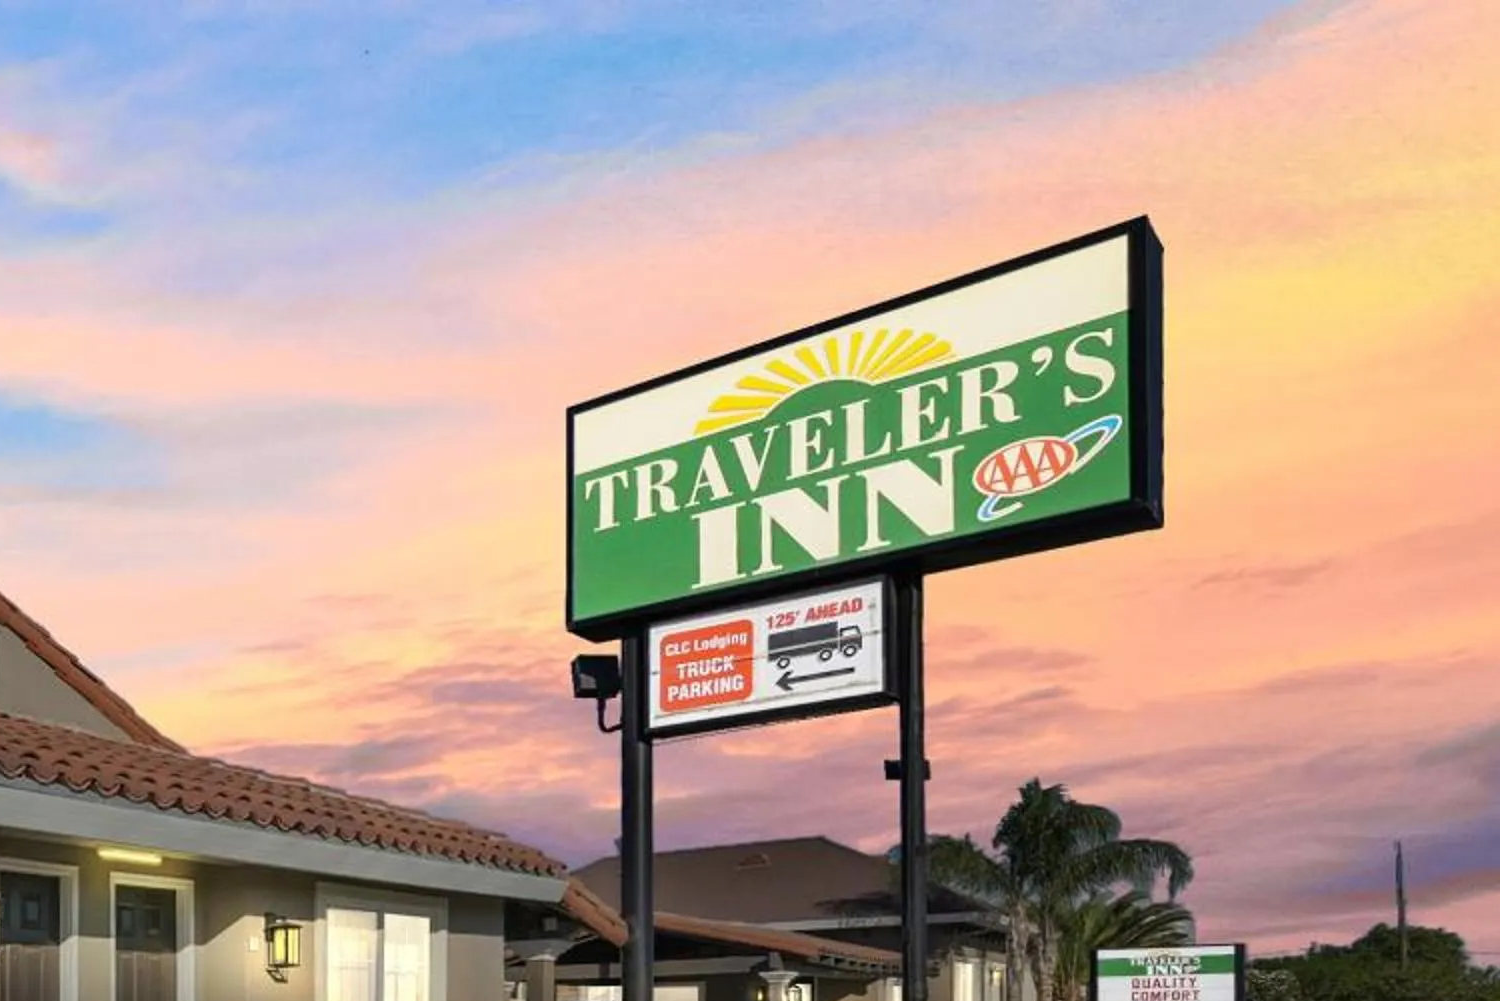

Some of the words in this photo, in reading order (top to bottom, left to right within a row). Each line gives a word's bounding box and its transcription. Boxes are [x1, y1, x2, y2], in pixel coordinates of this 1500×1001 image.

[585, 328, 1116, 533] TRAVELER'S
[984, 439, 1072, 493] AAA
[691, 445, 966, 589] INN
[766, 611, 800, 630] 125'
[804, 597, 863, 623] AHEAD
[665, 640, 692, 656] CLC
[694, 631, 747, 653] Lodging
[676, 656, 735, 679] TRUCK
[667, 675, 744, 700] PARKING
[1147, 965, 1183, 975] INN
[1131, 977, 1197, 989] QUALITY
[1131, 990, 1201, 1001] COMFORT
